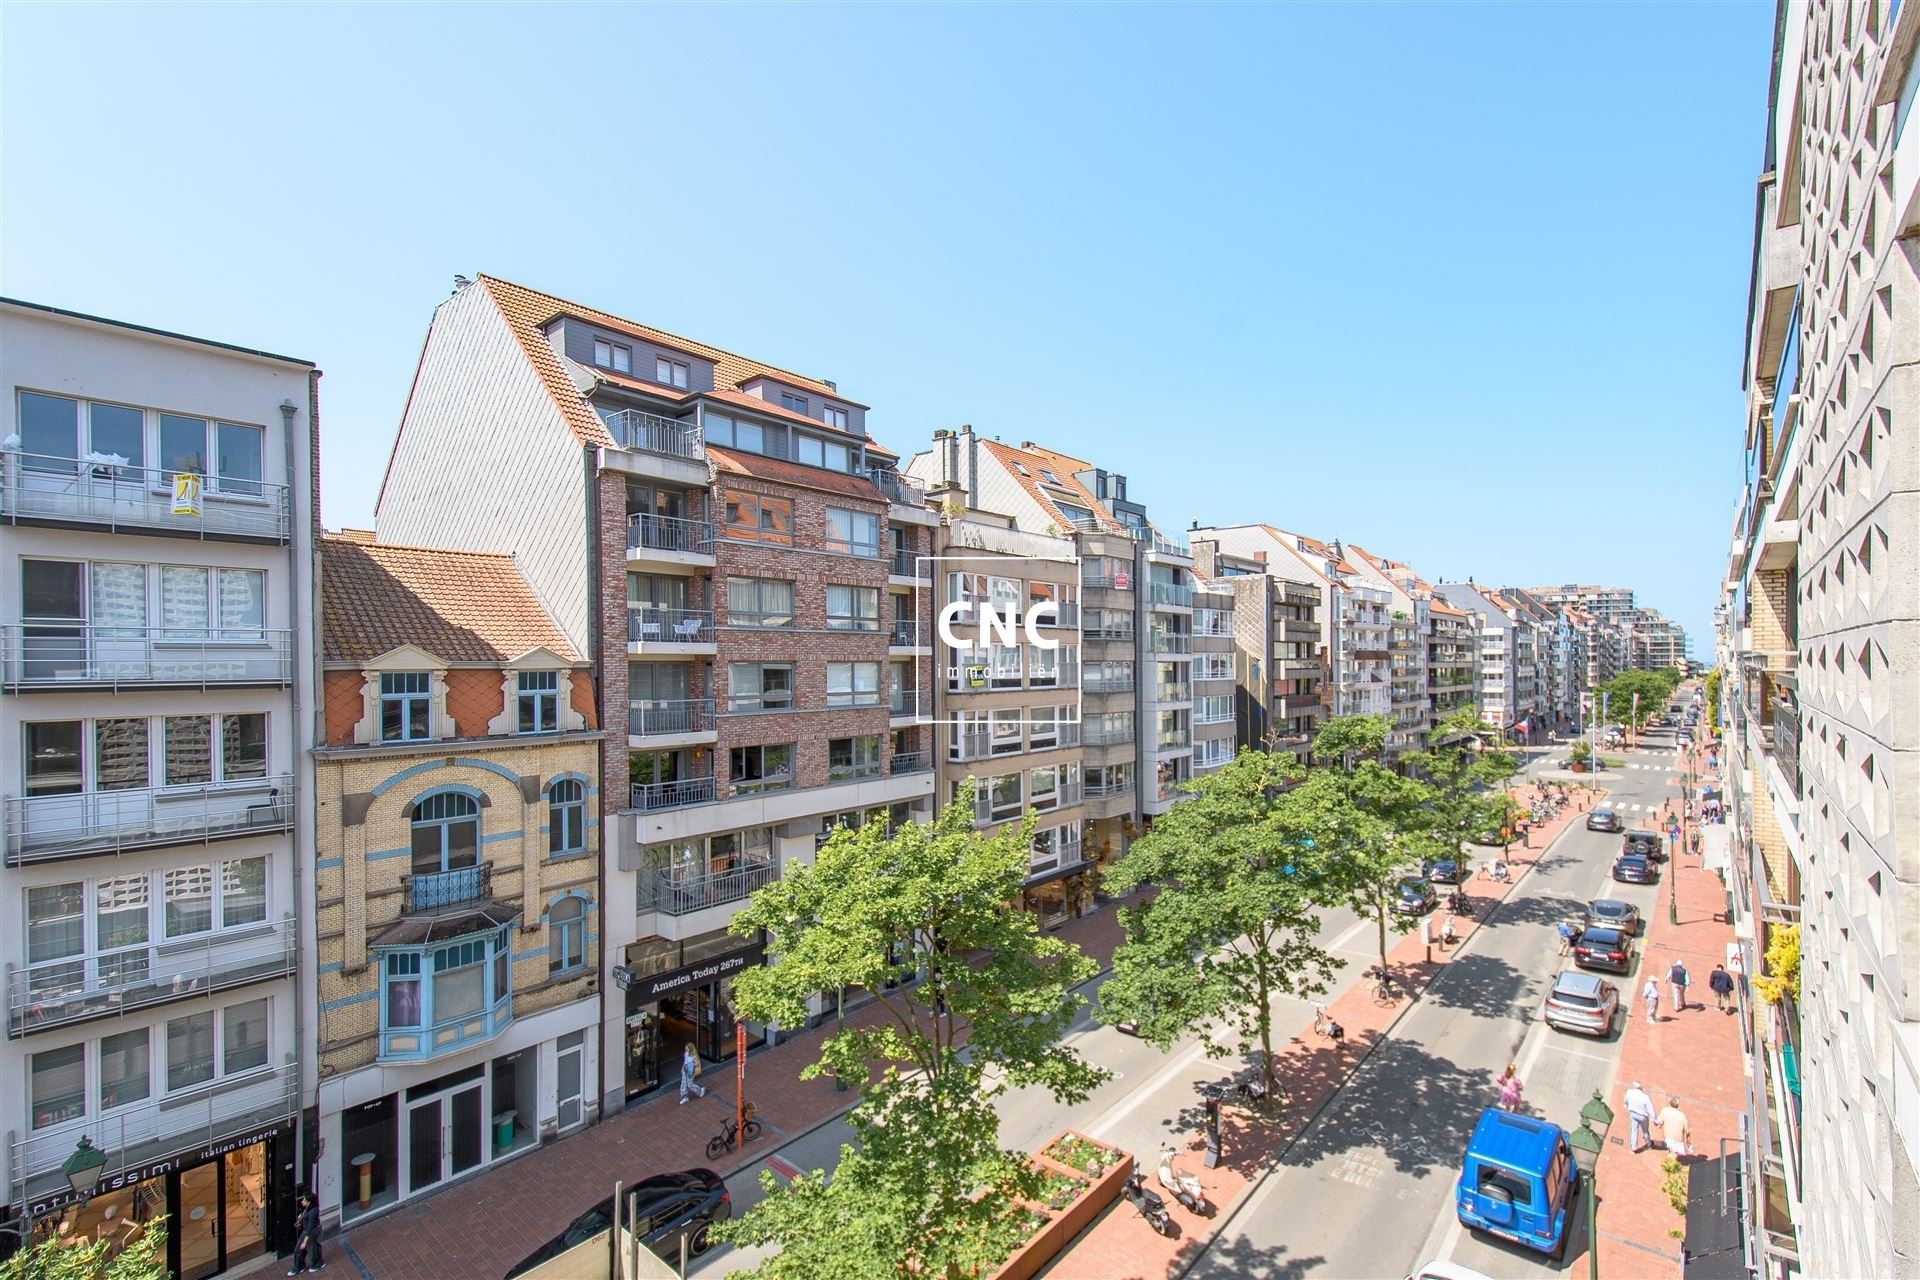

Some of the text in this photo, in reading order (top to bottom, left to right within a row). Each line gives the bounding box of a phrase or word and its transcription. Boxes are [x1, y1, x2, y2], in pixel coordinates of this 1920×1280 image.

[652, 975, 690, 993] America
[692, 965, 719, 980] Today
[238, 1129, 278, 1146] lingerie
[33, 1158, 180, 1214] ntiissimi
